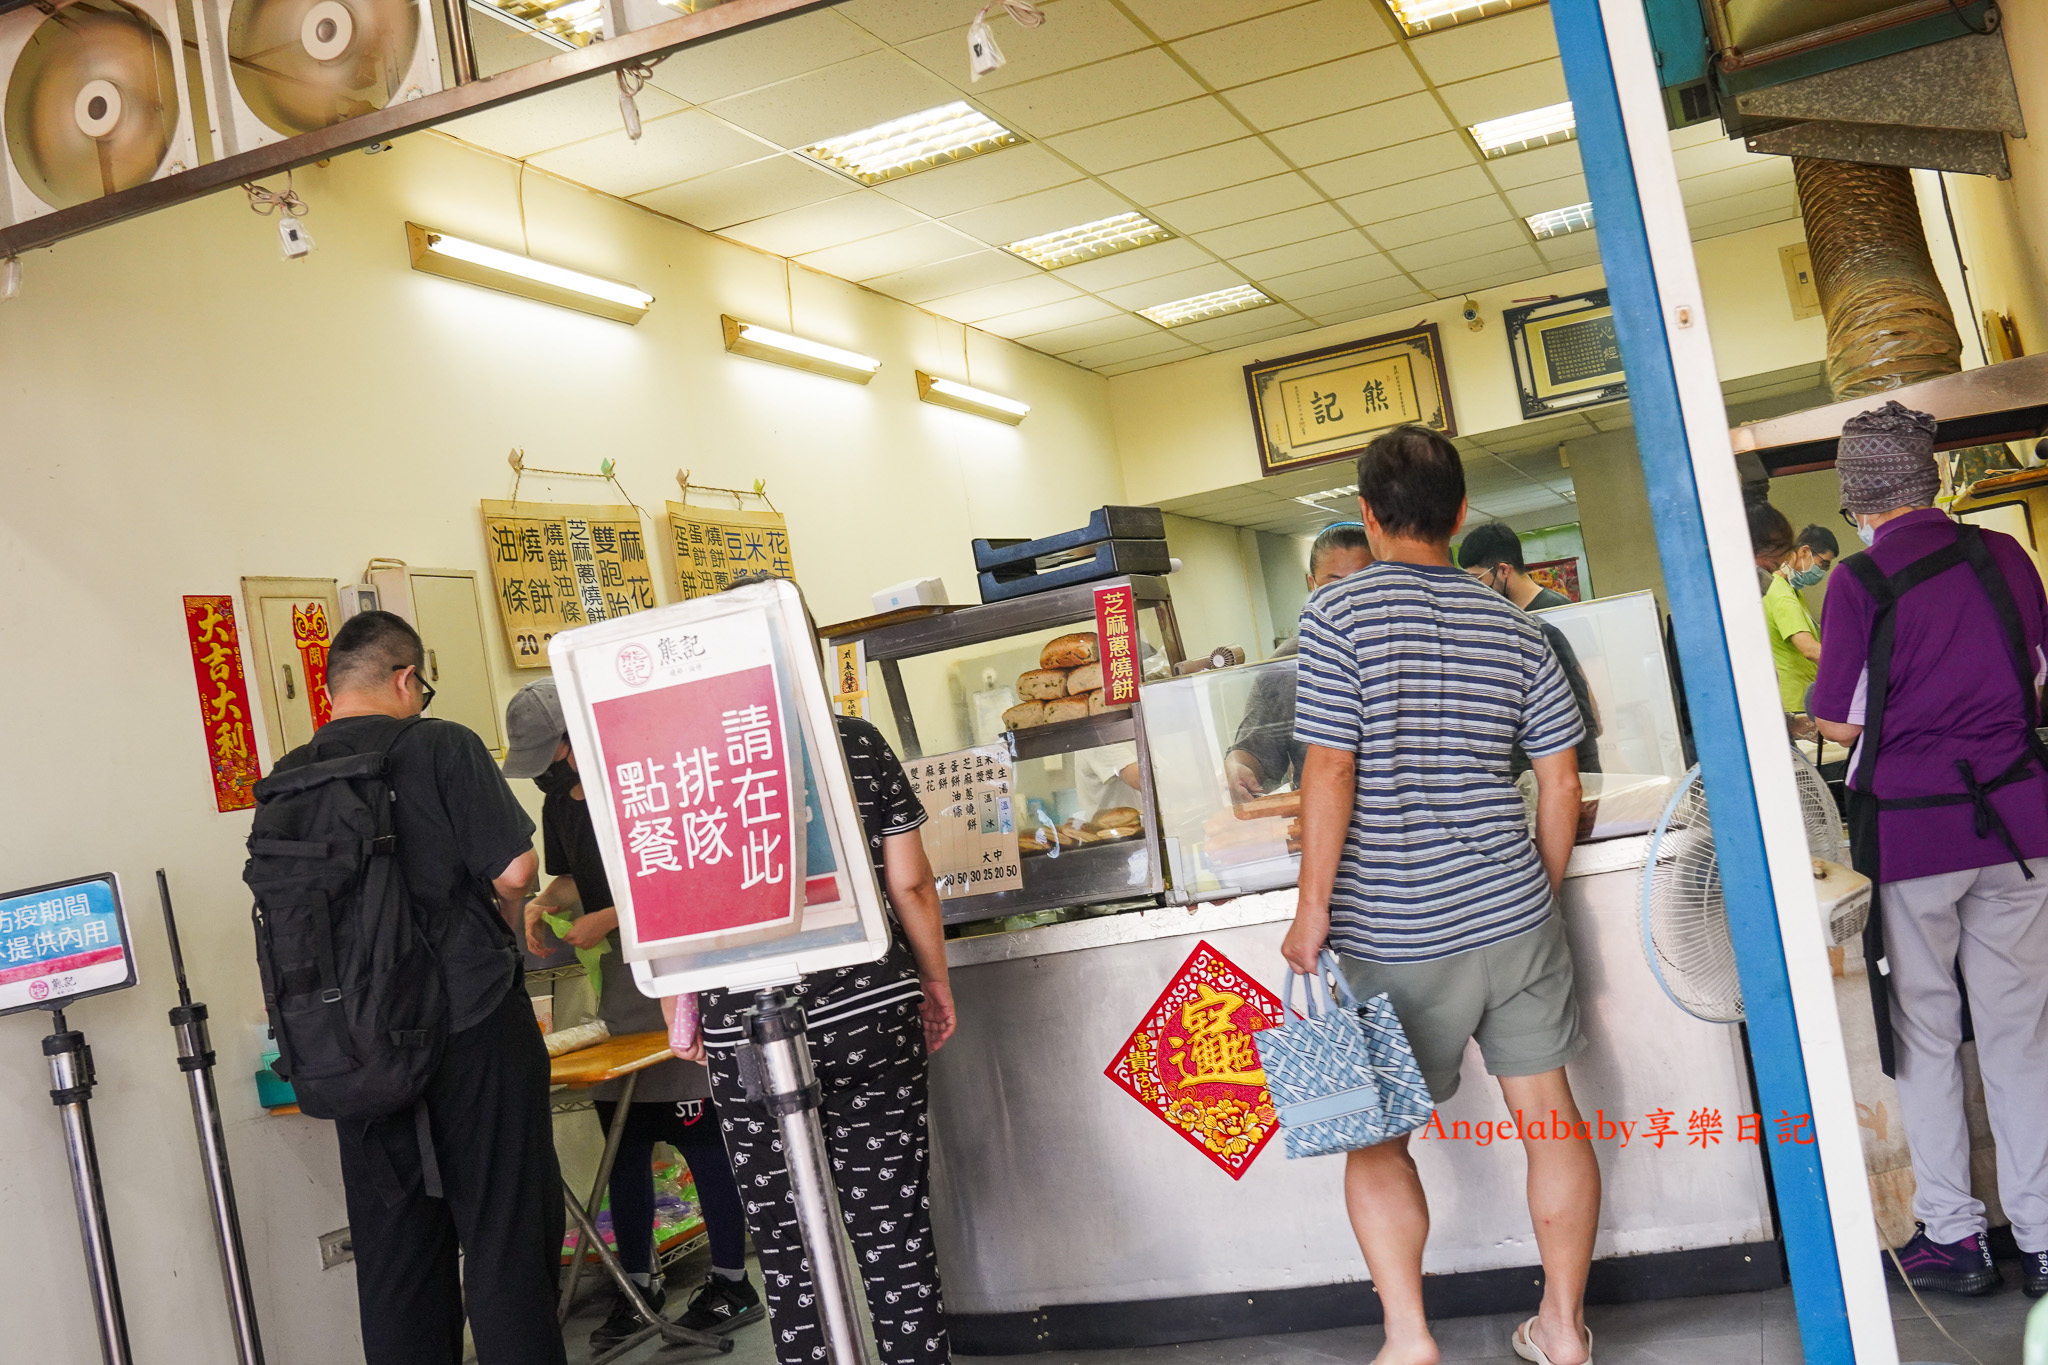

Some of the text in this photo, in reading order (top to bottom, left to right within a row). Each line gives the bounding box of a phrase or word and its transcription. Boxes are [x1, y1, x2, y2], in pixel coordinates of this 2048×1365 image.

[492, 525, 530, 615] 油條
[518, 526, 555, 614] 燒餅
[543, 523, 582, 624] 燒餅油條
[592, 525, 631, 619] 雙胞胎
[618, 529, 654, 610] 麻花
[674, 524, 698, 600] 蛋餅
[688, 523, 714, 596] 蛋餅油
[198, 603, 248, 759] 大吉大利
[517, 634, 540, 656] 20
[658, 635, 706, 667] 熊記
[1102, 591, 1134, 701] 芝麻蔥燒餅
[616, 757, 683, 878] 點餐
[672, 745, 734, 870] 排隊
[721, 704, 784, 890] 請在此
[925, 764, 936, 793] 麻花
[957, 872, 968, 885] 50
[970, 869, 981, 882] 30
[983, 868, 993, 881] 25
[994, 866, 1004, 879] 20
[1006, 864, 1018, 877] 50
[982, 848, 1003, 863] 大 中
[0, 920, 109, 963] 提供內用
[1124, 1033, 1160, 1104] 富貴吉祥
